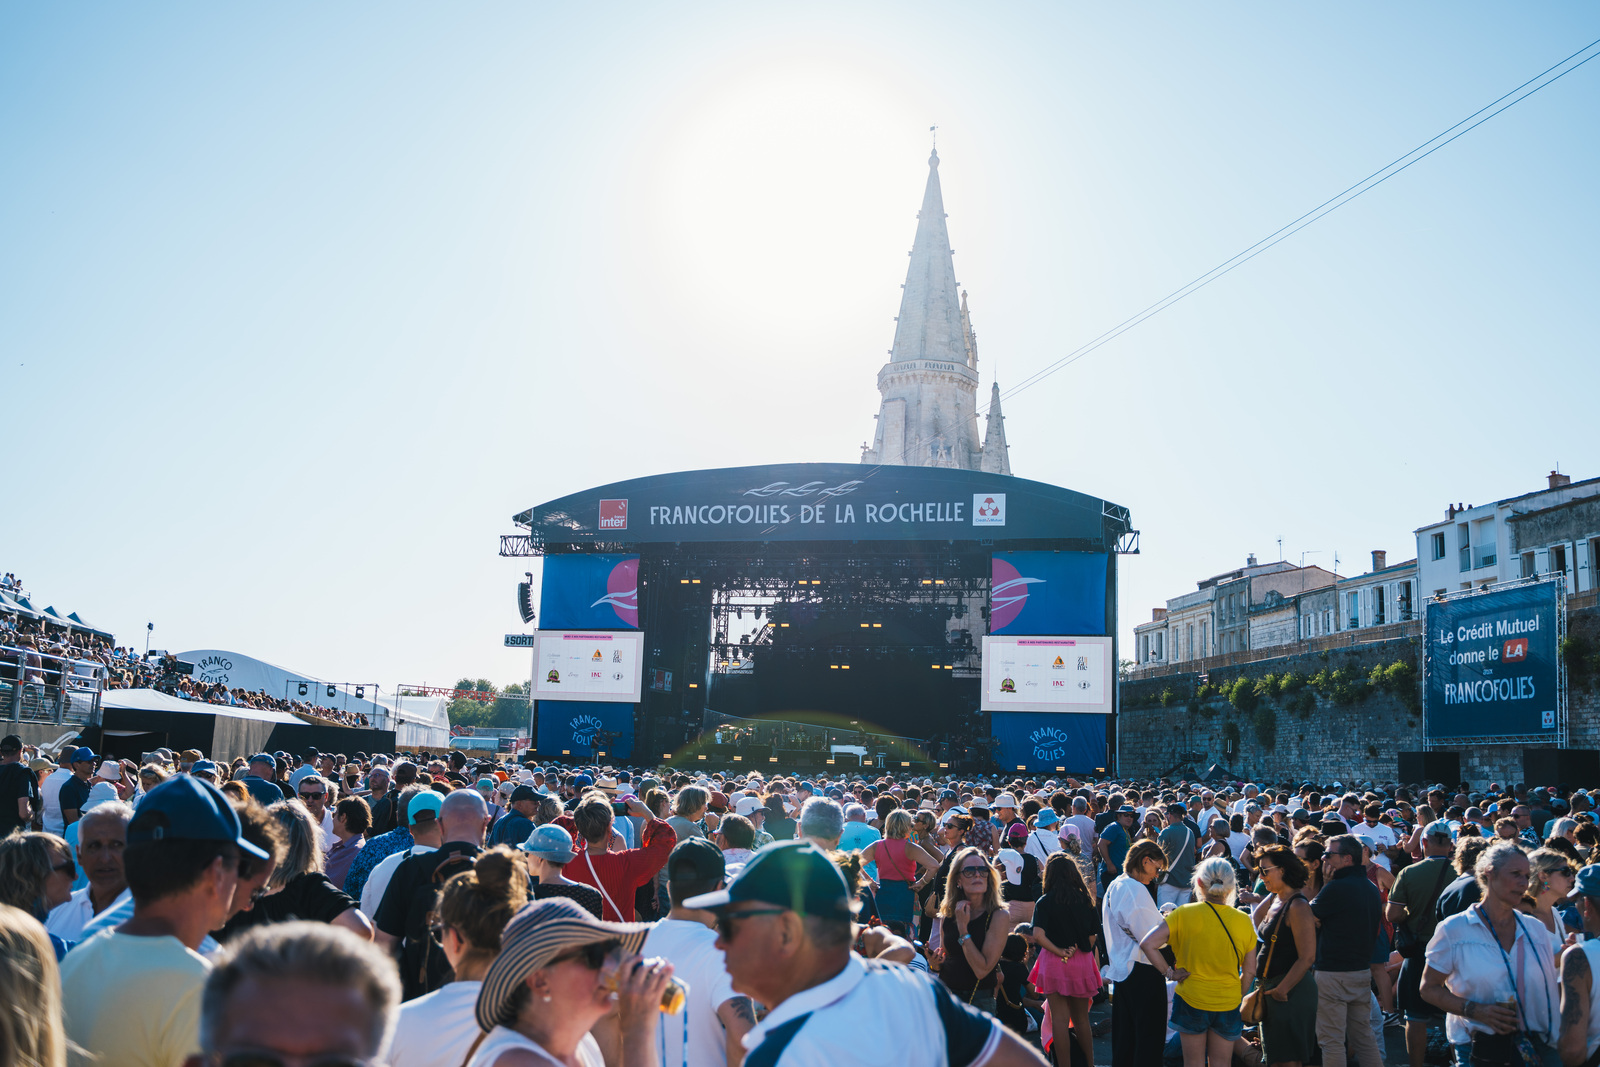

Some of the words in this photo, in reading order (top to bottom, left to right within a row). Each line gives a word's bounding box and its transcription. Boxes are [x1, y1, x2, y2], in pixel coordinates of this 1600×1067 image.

[601, 516, 625, 527] inter
[650, 505, 791, 525] FRANCOFOLIES
[800, 504, 826, 524] DE
[835, 504, 856, 523] LA
[865, 502, 965, 523] ROCHELLE
[1440, 629, 1454, 644] Le
[1457, 623, 1493, 642] Crédit
[1496, 614, 1540, 636] Mutuel
[1449, 650, 1485, 665] donne
[1488, 645, 1499, 661] le
[1506, 644, 1523, 658] LA
[198, 656, 233, 671] FRANCO
[417, 686, 496, 702] FRANCOFOLIES
[1444, 675, 1536, 705] FRANCOFOLIES
[569, 714, 603, 730] FRANCO
[572, 731, 597, 746] FOLI
[1029, 727, 1068, 743] FRANCO
[1032, 746, 1066, 761] FOLIES
